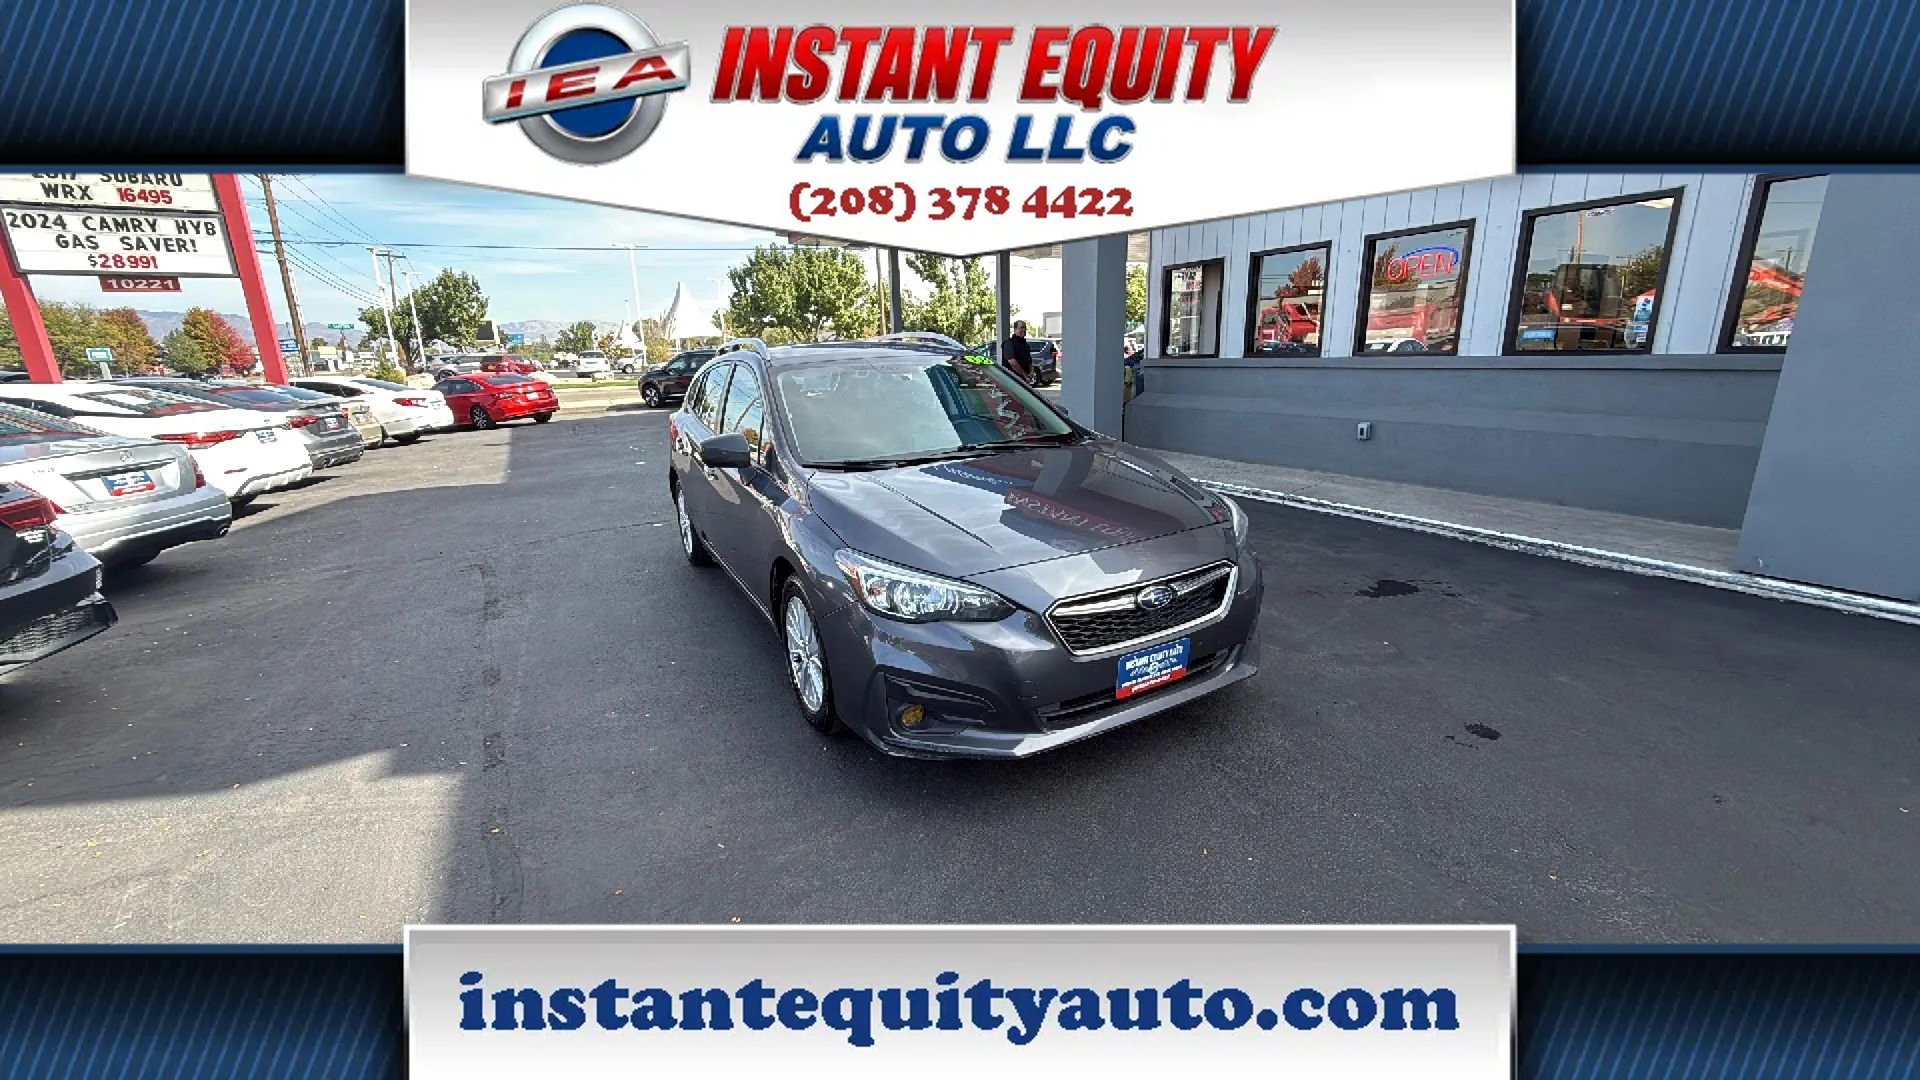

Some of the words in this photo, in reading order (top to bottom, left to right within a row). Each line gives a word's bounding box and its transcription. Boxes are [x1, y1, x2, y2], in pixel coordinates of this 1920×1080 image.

[100, 172, 183, 187] SUBARU
[40, 181, 94, 201] WRX
[116, 187, 173, 205] 16495
[6, 211, 67, 230] 2024
[82, 215, 158, 234] CAMRY
[175, 219, 217, 236] HYB
[55, 233, 100, 250] GAS
[119, 235, 198, 253] SAVER!
[87, 253, 159, 270] $28991
[1388, 251, 1455, 282] OPEN
[107, 278, 175, 290] 10221
